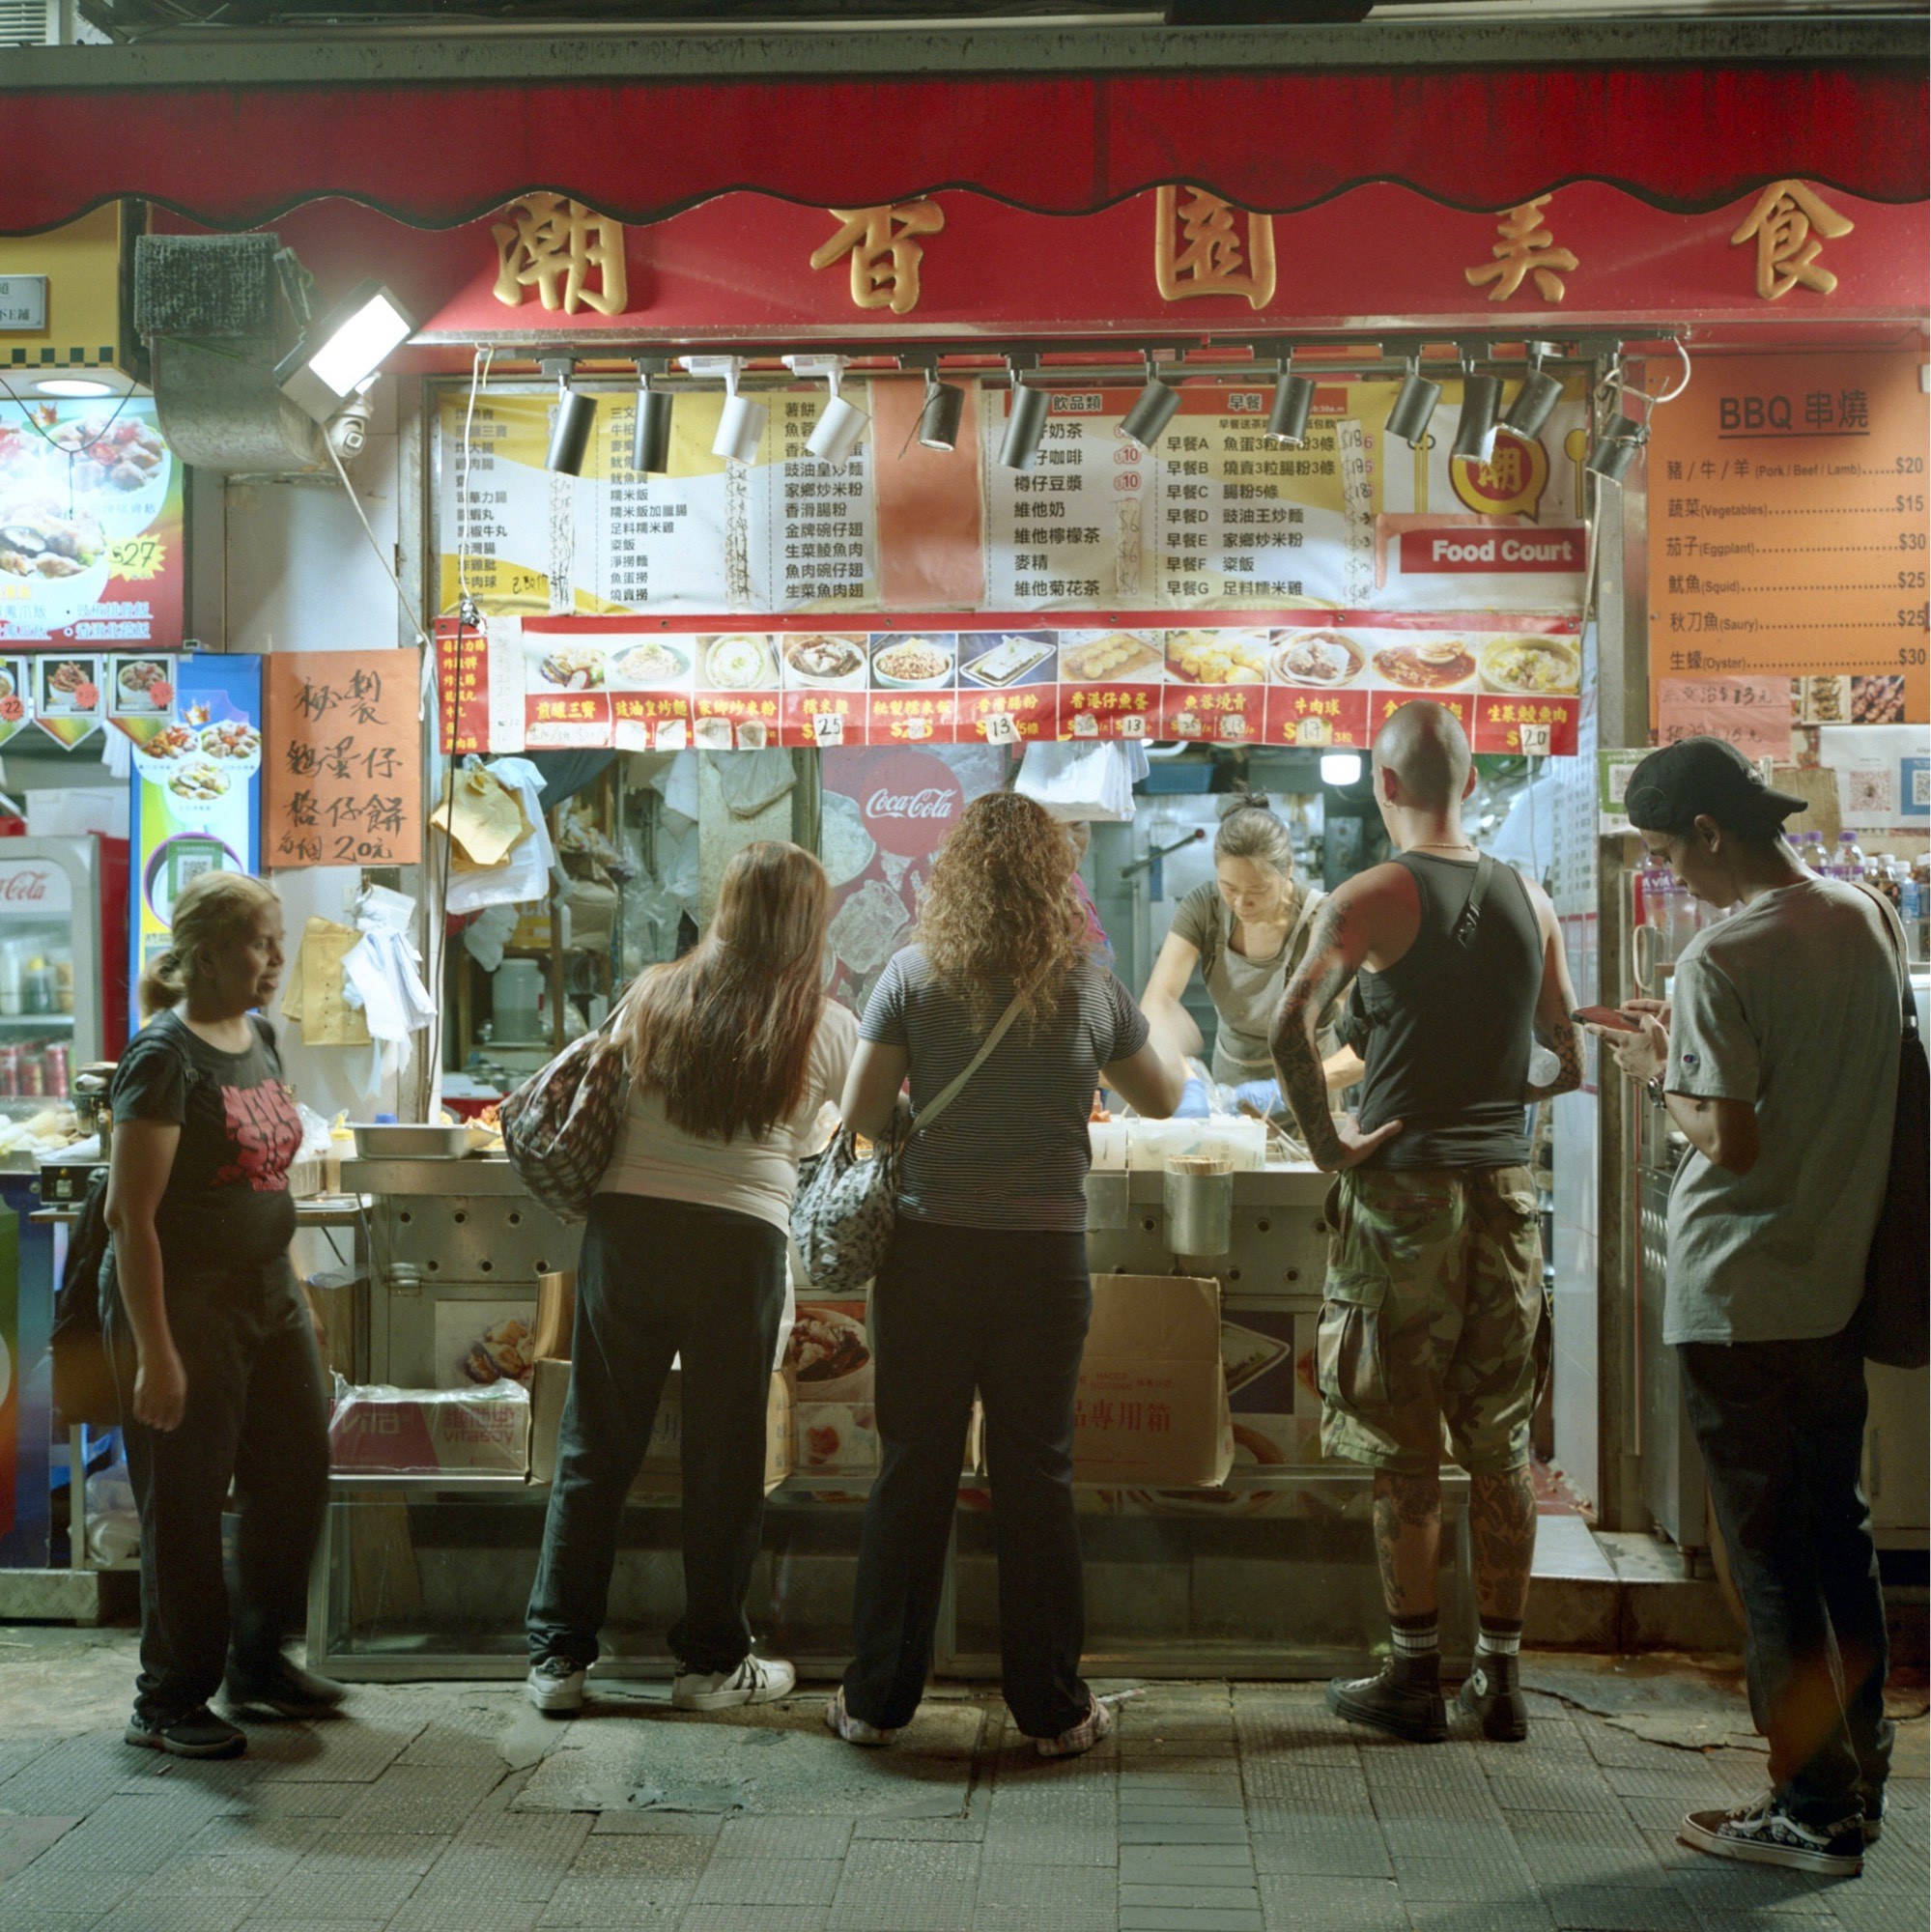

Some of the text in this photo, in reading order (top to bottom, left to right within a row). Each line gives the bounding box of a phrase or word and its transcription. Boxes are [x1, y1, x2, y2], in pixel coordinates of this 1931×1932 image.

[784, 402, 815, 417] 薯餅
[1052, 394, 1103, 412] 飲品類
[1228, 394, 1262, 412] 早餐
[1719, 389, 1869, 431] BBQ 串燒
[1167, 436, 1209, 450] 早餐A
[1167, 460, 1209, 474] 早餐B
[1667, 460, 1683, 480] 豬
[1700, 459, 1717, 479] 牛
[1734, 459, 1750, 478] 羊
[1794, 464, 1820, 476] Beef
[1895, 457, 1923, 475] $20
[611, 489, 648, 502] 糯米飯
[784, 482, 864, 498] 家鄉炒米粉
[1167, 484, 1209, 499] 早餐C
[784, 502, 847, 519] 香滑腸粉
[1014, 501, 1065, 518] 維他奶
[1896, 495, 1924, 513] $15
[1167, 508, 1209, 523] 早餐D
[784, 523, 864, 538] 金牌碗仔翅
[1014, 527, 1100, 545] 維他檸檬茶
[1167, 532, 1304, 548] 早餐E 家鄉炒米粉
[1899, 533, 1926, 552] $30
[1433, 539, 1573, 563] Food Court
[785, 562, 865, 580] 魚肉碗仔翅
[1014, 554, 1048, 571] 麥精
[1167, 556, 1207, 571] 早餐F
[1014, 580, 1100, 597] 維他菊花茶
[1167, 581, 1209, 596] 早餐G
[1897, 572, 1925, 589] $25
[785, 582, 866, 599] 生菜魚肉翅
[1897, 610, 1926, 628] $25
[1898, 647, 1926, 667] $30
[1070, 692, 1149, 711] 香港仔魚蛋
[1293, 696, 1342, 718] 牛肉球
[866, 788, 957, 819] Coca-Cola
